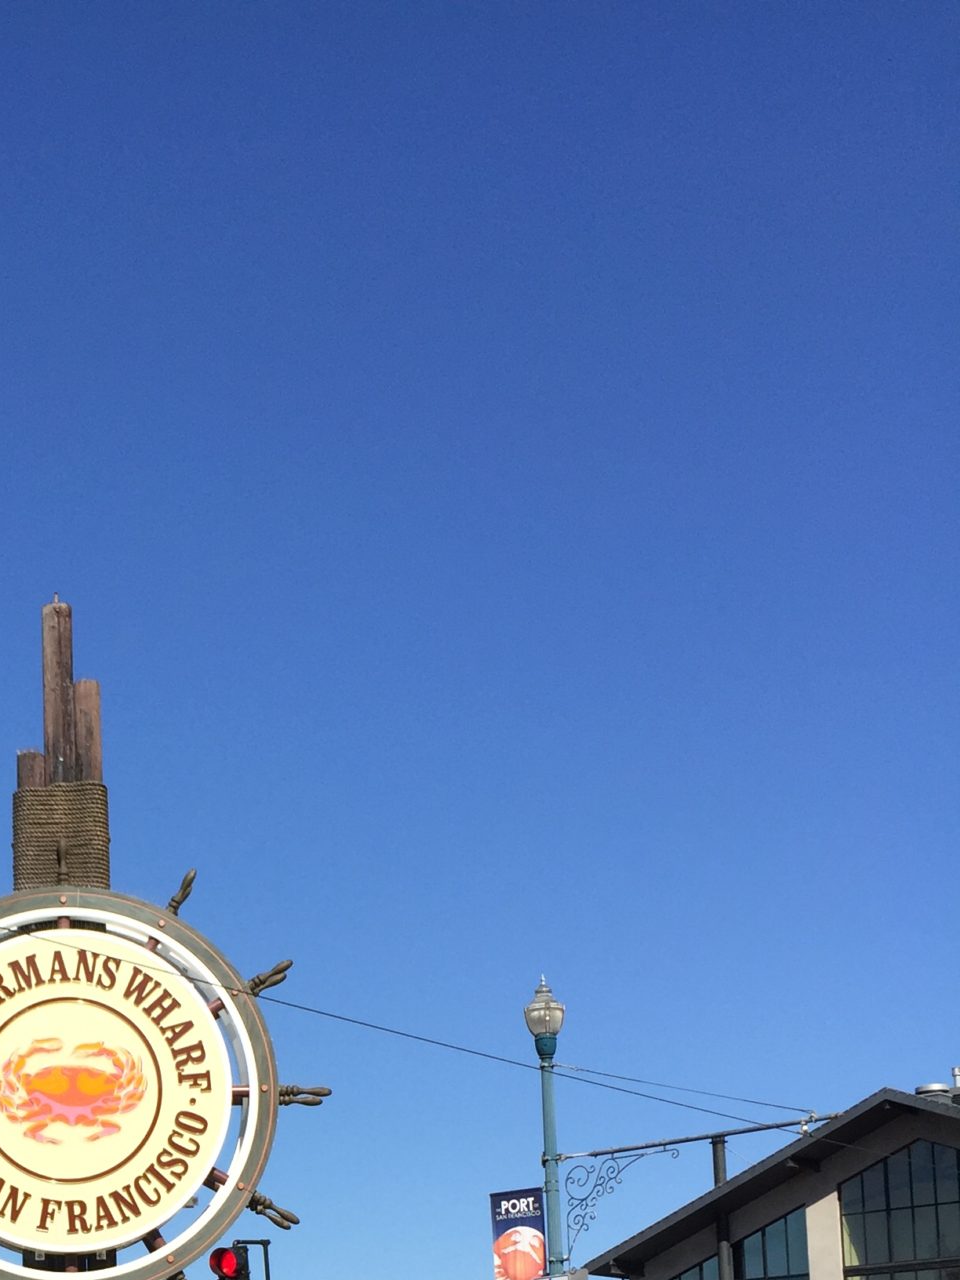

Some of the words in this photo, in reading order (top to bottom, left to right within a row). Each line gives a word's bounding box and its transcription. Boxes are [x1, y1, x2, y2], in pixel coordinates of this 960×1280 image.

[124, 966, 212, 1094] WHARF
[36, 1110, 209, 1235] FRANCISCO
[501, 1197, 534, 1214] PORT
[508, 1210, 541, 1218] FRANCISCO
